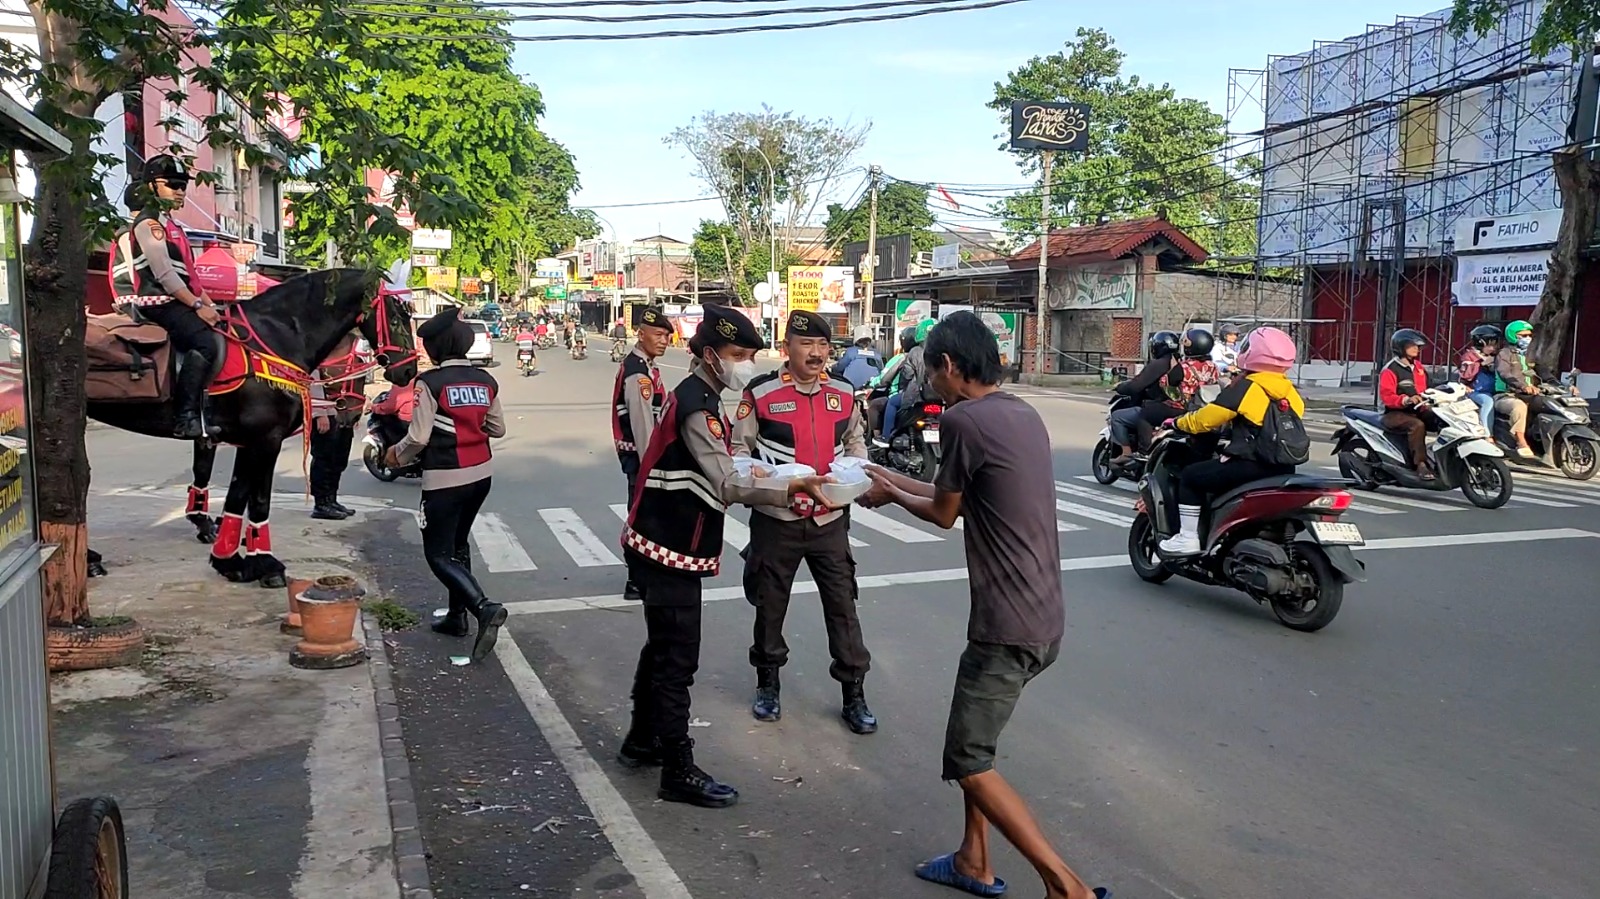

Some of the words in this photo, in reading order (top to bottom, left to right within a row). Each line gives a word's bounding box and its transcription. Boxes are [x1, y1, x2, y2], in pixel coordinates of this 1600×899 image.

[1497, 220, 1539, 237] FATIHO
[1482, 266, 1506, 274] SEWA
[1507, 264, 1543, 273] KAMERA
[1471, 276, 1491, 284] JUAL
[1500, 275, 1516, 283] BELI
[1517, 273, 1548, 281] KAMER
[798, 282, 818, 290] EKOR
[1483, 284, 1507, 293] SEWA
[1508, 283, 1539, 292] IPHONE
[449, 387, 489, 405] POLISI
[770, 402, 796, 412] SUGIONO
